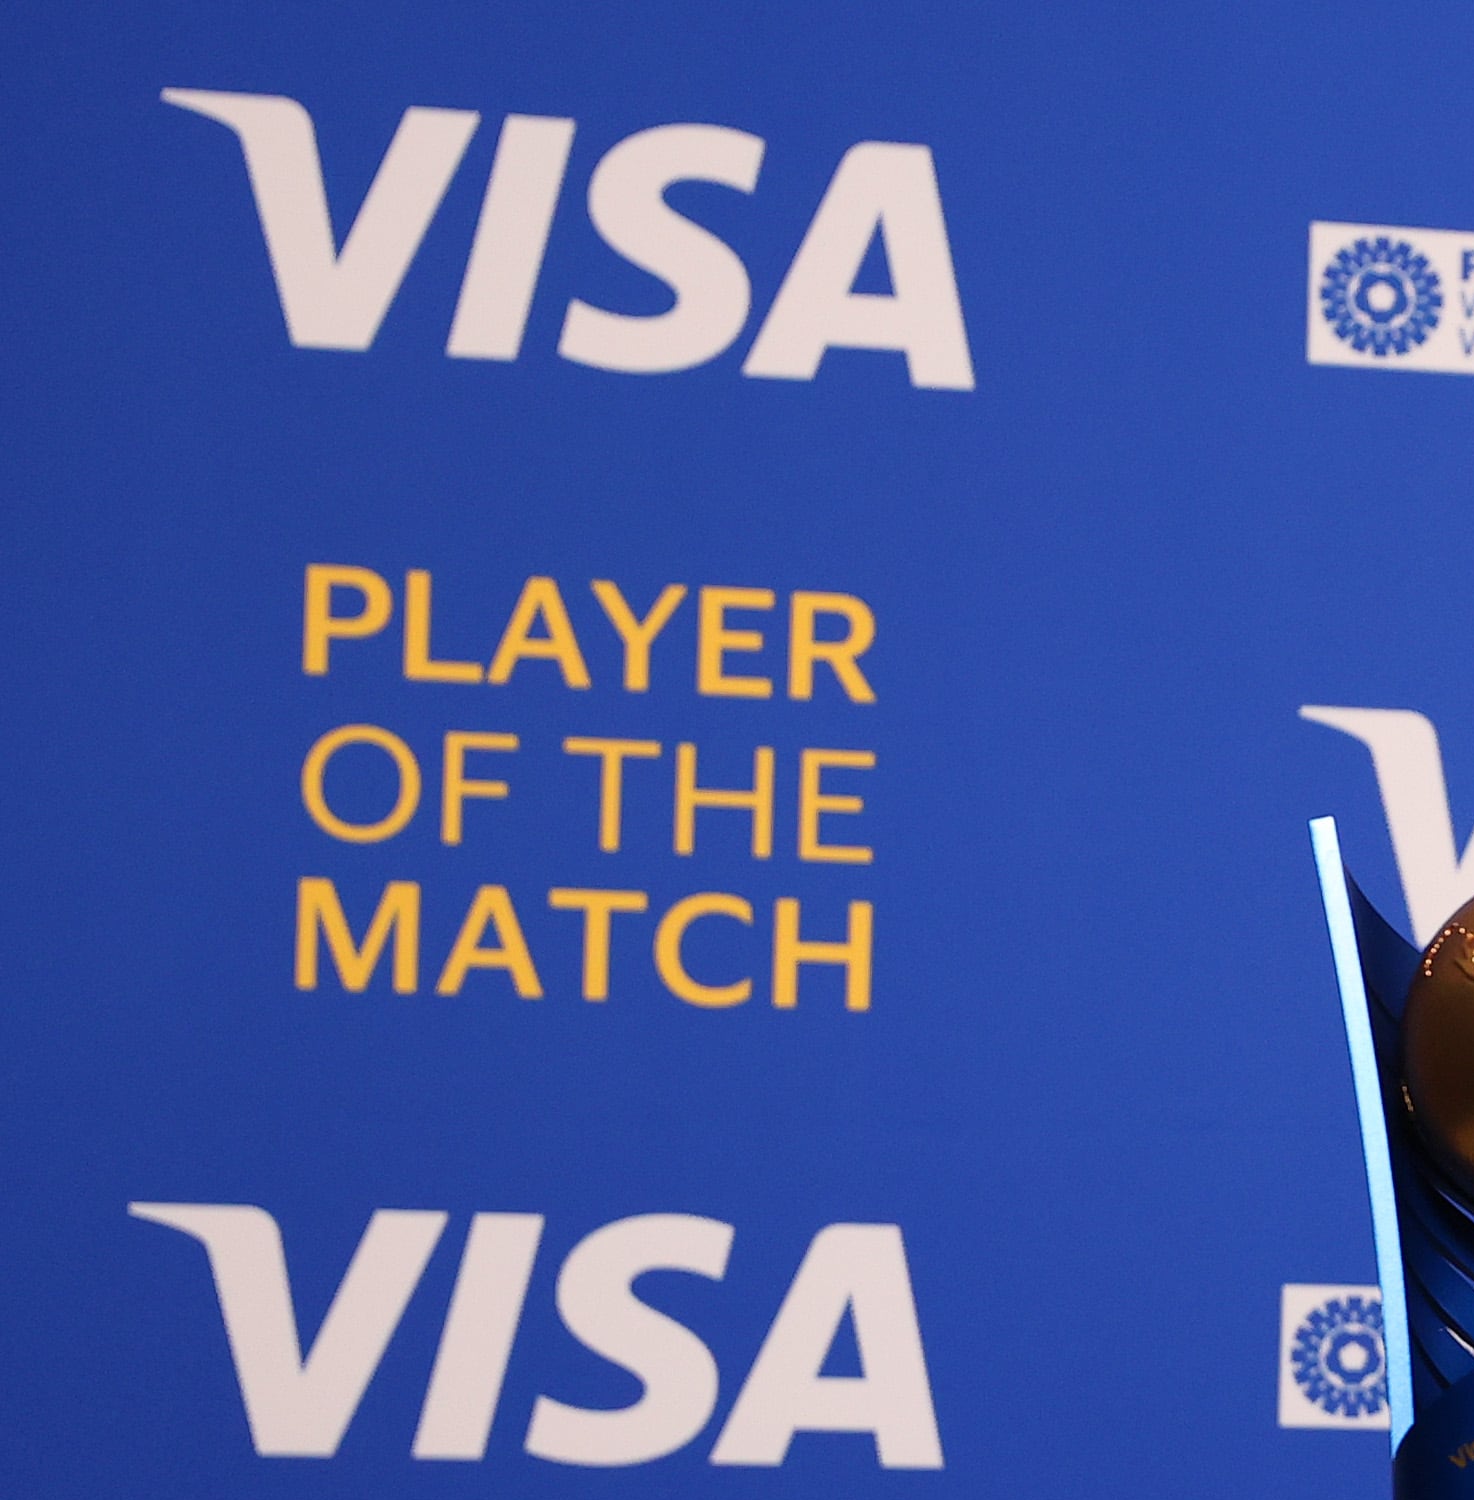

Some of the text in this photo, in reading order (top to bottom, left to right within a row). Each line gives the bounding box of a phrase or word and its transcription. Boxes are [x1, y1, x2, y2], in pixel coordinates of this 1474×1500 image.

[161, 86, 975, 391] VISA
[302, 562, 876, 703] PLAYER
[301, 722, 876, 864] OF THE
[294, 876, 873, 1011] MATCH
[127, 1201, 944, 1469] VISA
